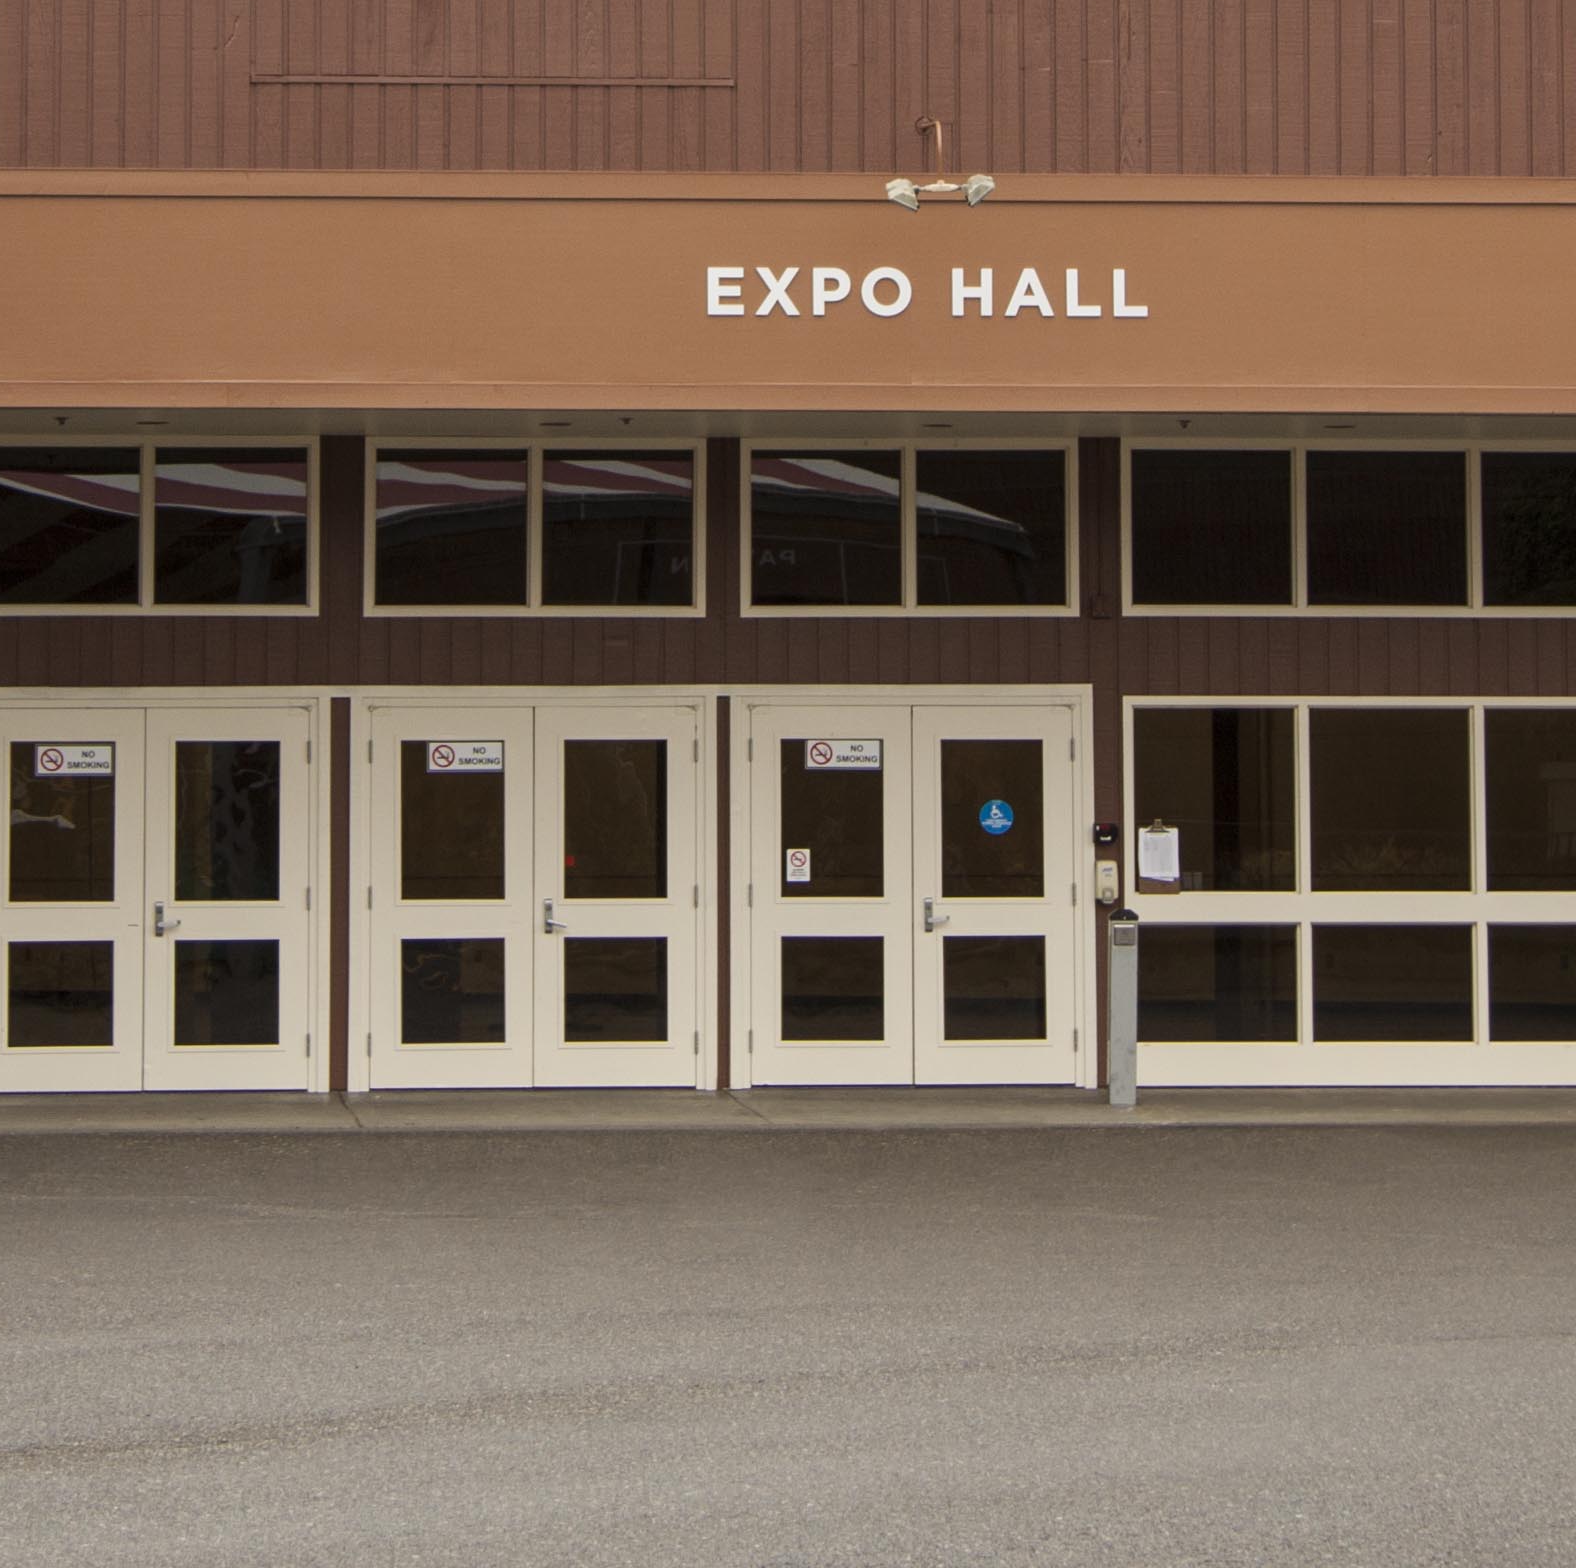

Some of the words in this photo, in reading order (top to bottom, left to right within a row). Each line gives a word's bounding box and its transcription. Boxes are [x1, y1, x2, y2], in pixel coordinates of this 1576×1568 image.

[707, 266, 912, 317] EXPO
[951, 267, 1148, 318] HALL
[472, 746, 487, 754] NO
[850, 744, 864, 752] NO
[81, 750, 96, 758] NO
[458, 757, 501, 765] SMOKING
[836, 755, 878, 763] SMOKING
[67, 761, 110, 769] SMOKING
